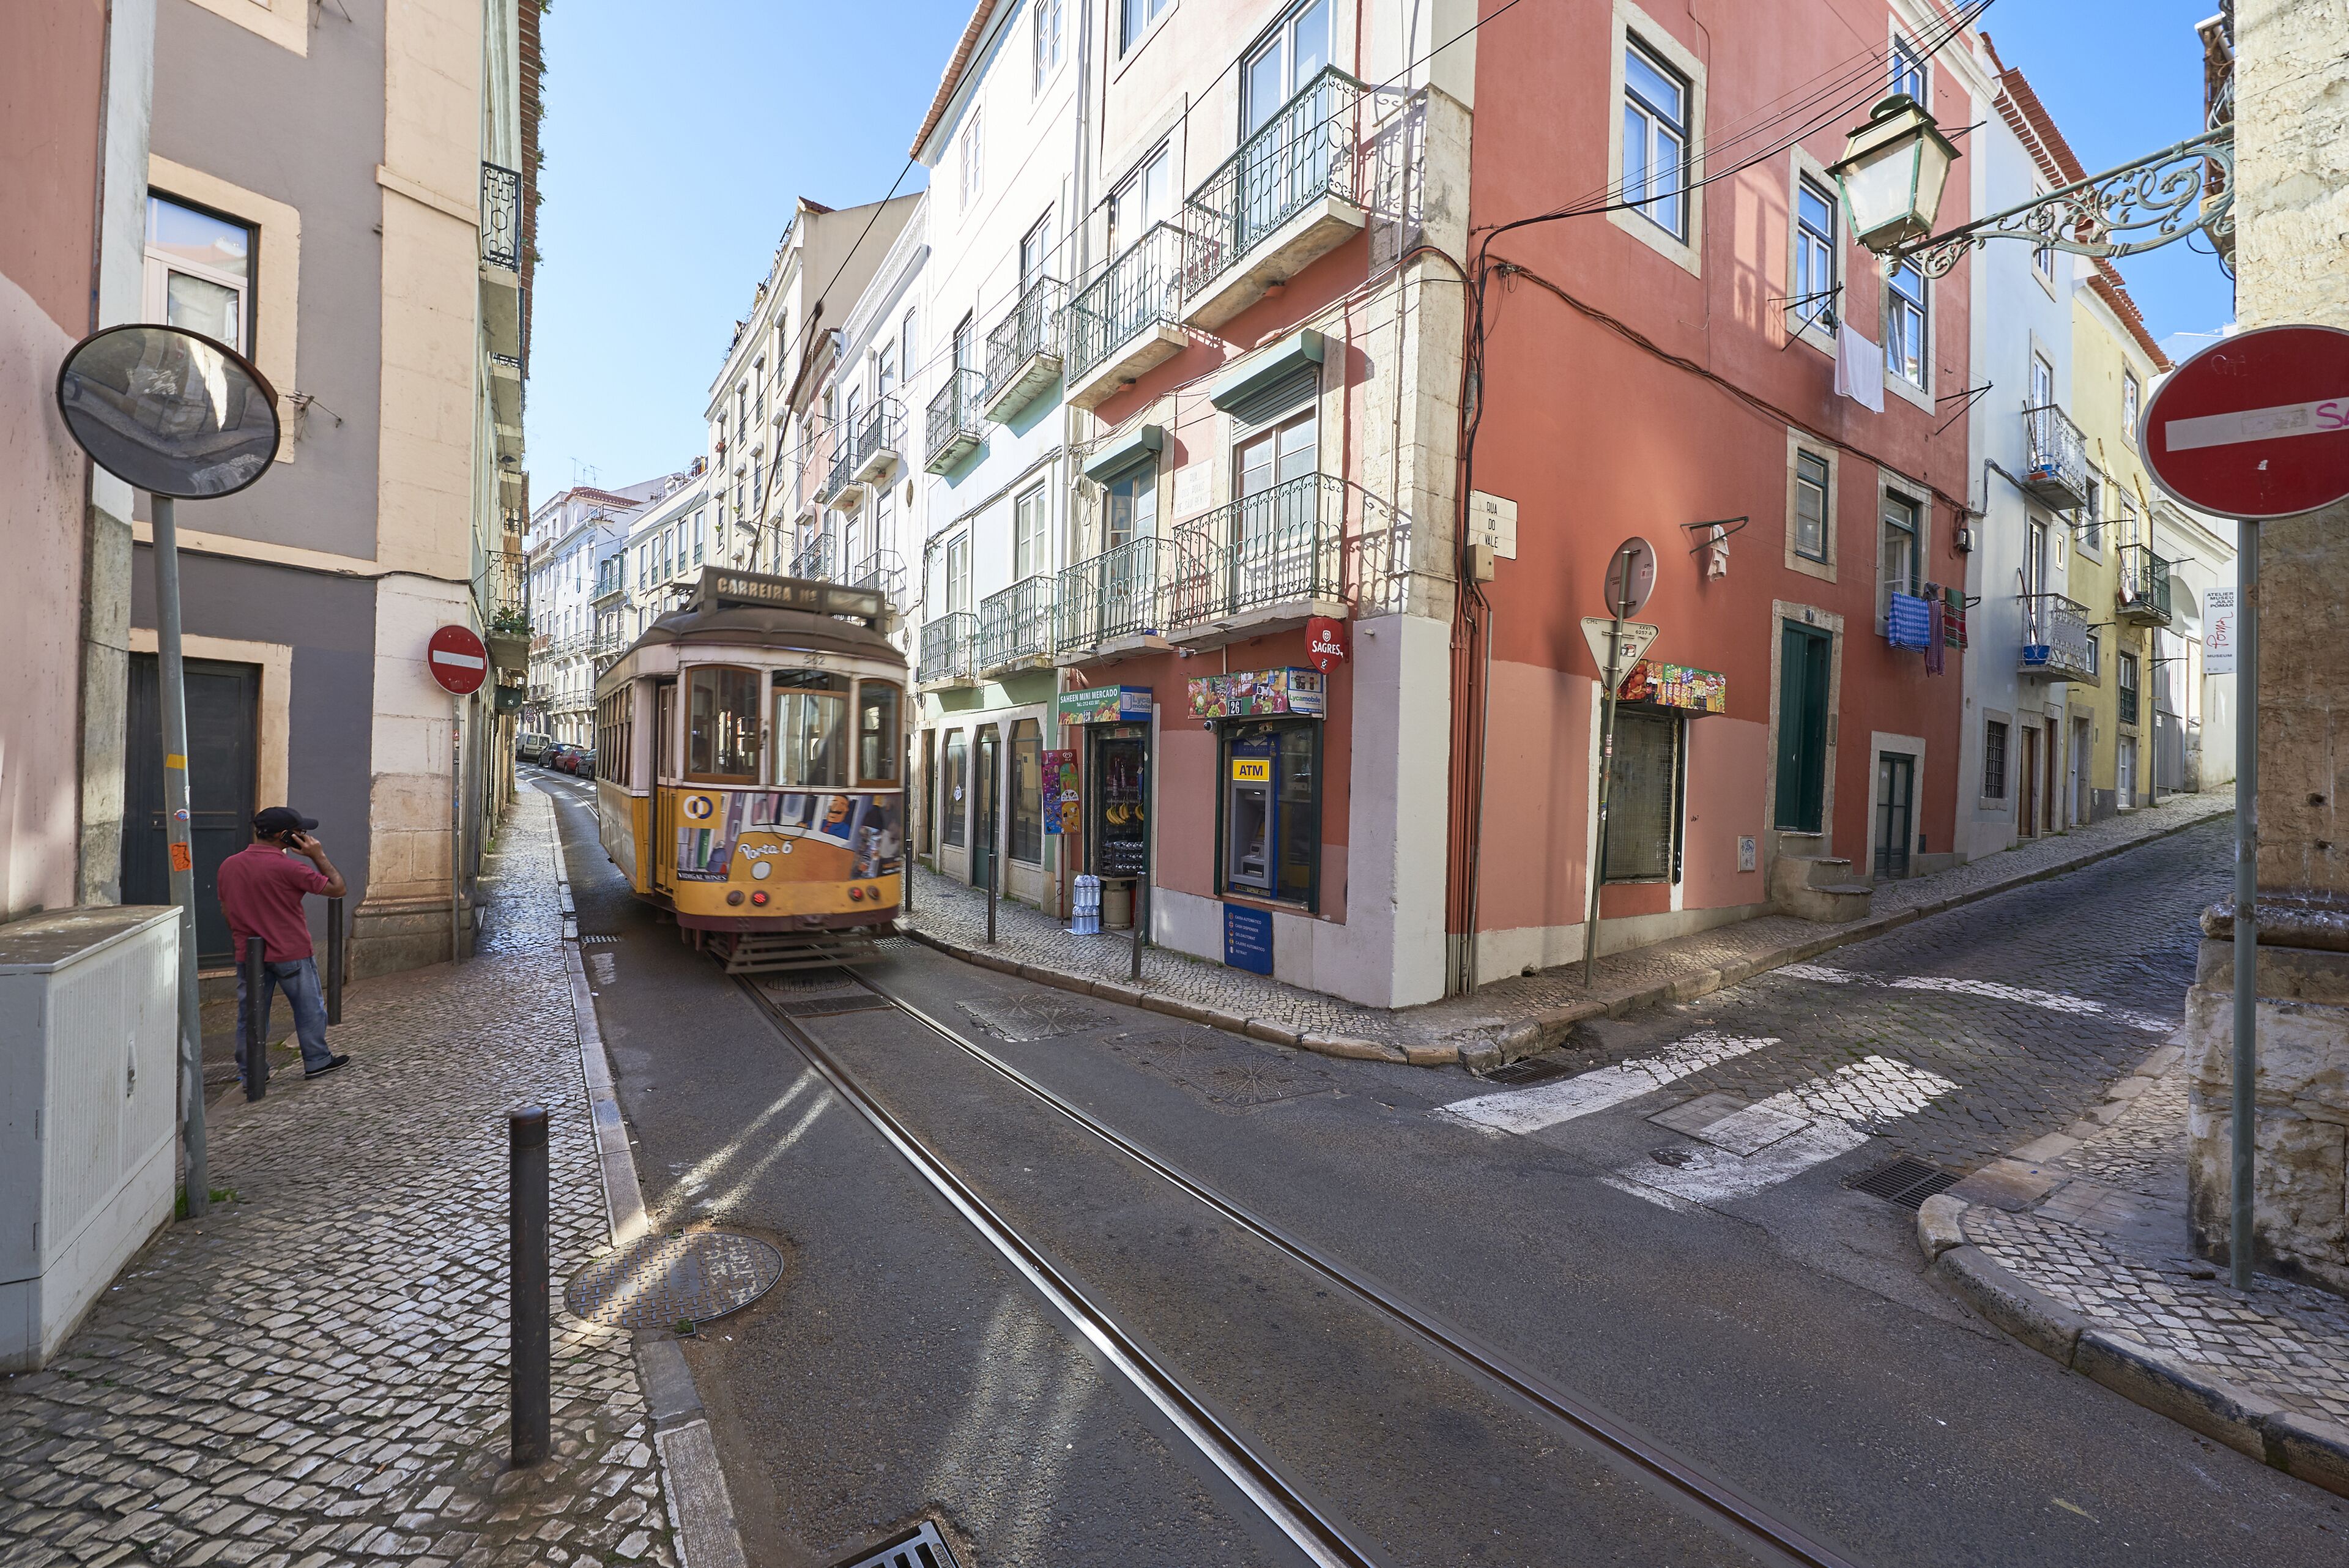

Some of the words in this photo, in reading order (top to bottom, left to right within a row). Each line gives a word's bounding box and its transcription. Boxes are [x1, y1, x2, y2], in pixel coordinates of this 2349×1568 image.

[1487, 502, 1497, 515] RUA
[1488, 518, 1496, 530] DO
[1485, 534, 1498, 548] VALE
[717, 577, 792, 601] CARREIRA
[1312, 641, 1340, 655] SAGRES
[1060, 694, 1078, 704] SAHEEN
[1079, 692, 1091, 701] MINI
[1091, 688, 1118, 699] MERCADO
[1132, 695, 1151, 704] Lyca
[1289, 694, 1321, 703] Lycamobile
[1230, 701, 1240, 714] 26
[1239, 765, 1263, 776] ATM
[738, 843, 780, 860] Porta
[782, 841, 793, 854] 6
